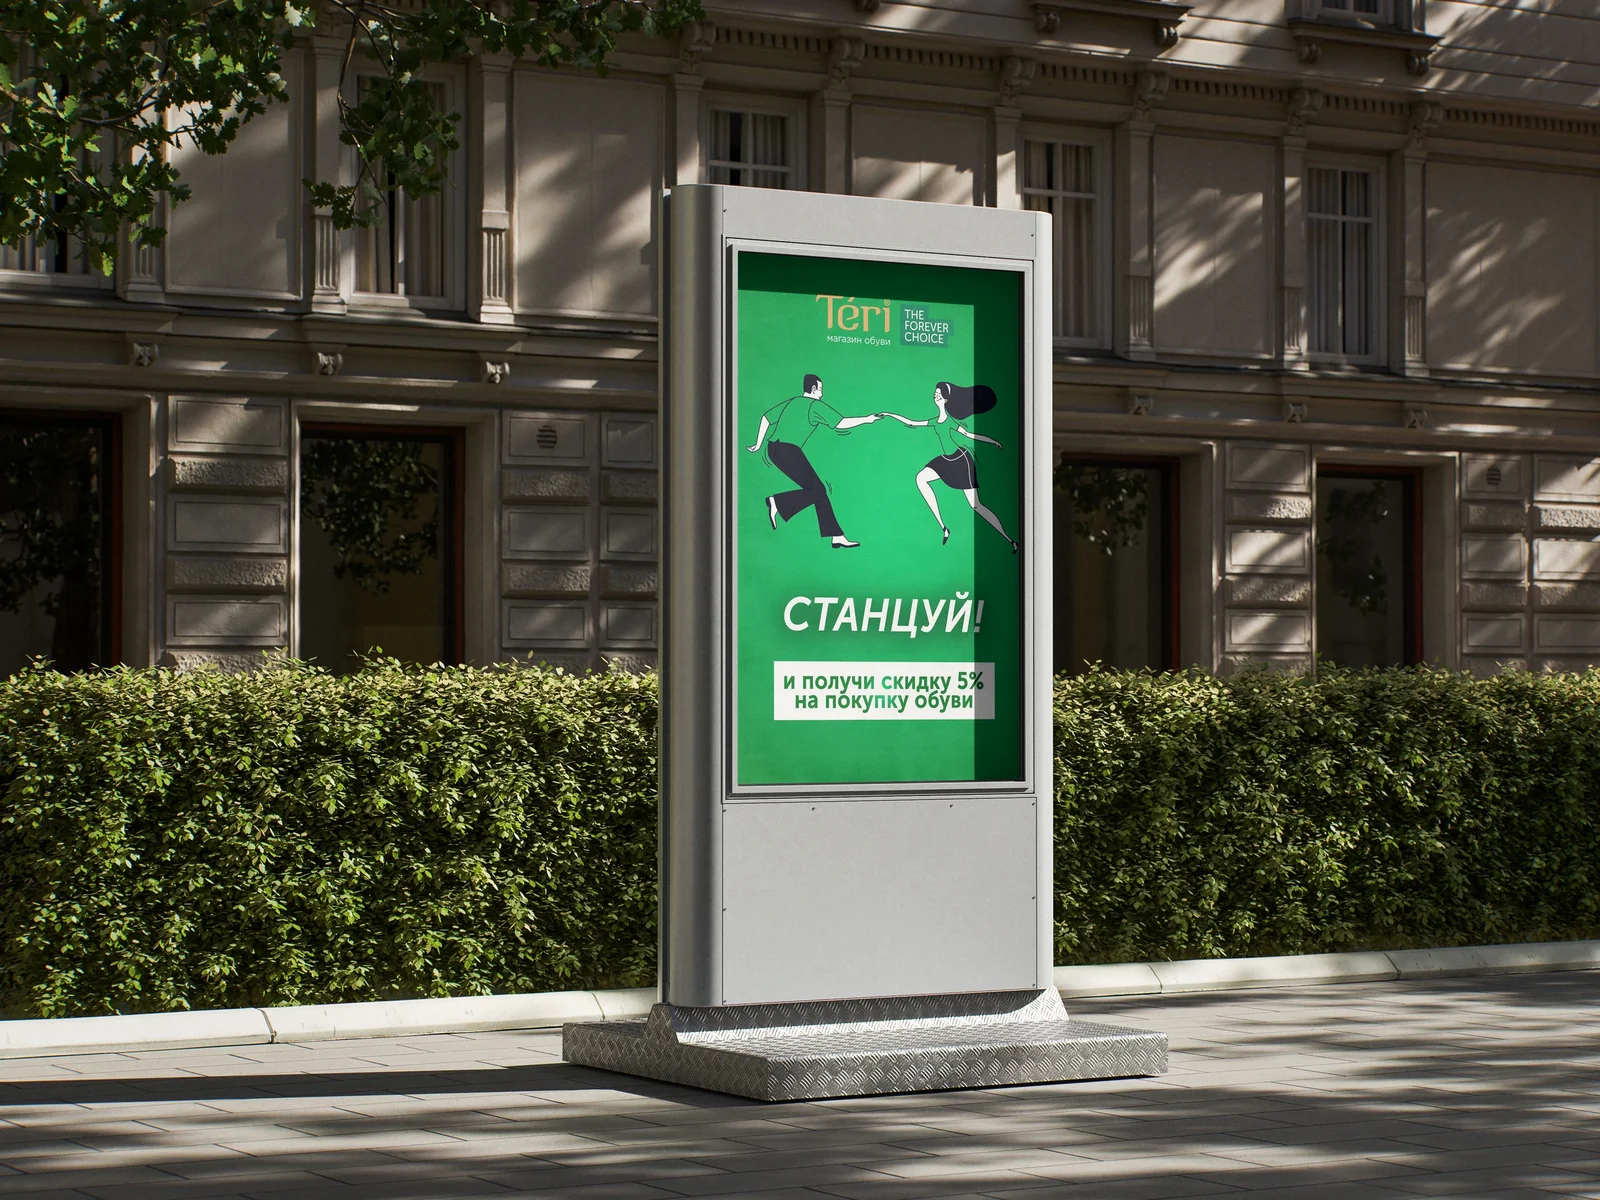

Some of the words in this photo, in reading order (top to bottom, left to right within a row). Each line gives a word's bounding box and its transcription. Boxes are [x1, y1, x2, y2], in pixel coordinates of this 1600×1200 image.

[904, 309, 925, 321] THE
[904, 320, 949, 333] FOREVER
[826, 335, 862, 344] магазин
[864, 336, 891, 346] обуви
[904, 332, 944, 344] CHOICE
[783, 591, 985, 639] СТАНЦУЙ!
[783, 675, 795, 690] и
[802, 675, 875, 694] получи
[881, 675, 952, 694] скидку
[957, 672, 984, 690] 5%
[795, 694, 819, 709] на
[825, 694, 909, 713] покупку
[914, 691, 973, 713] обуви
